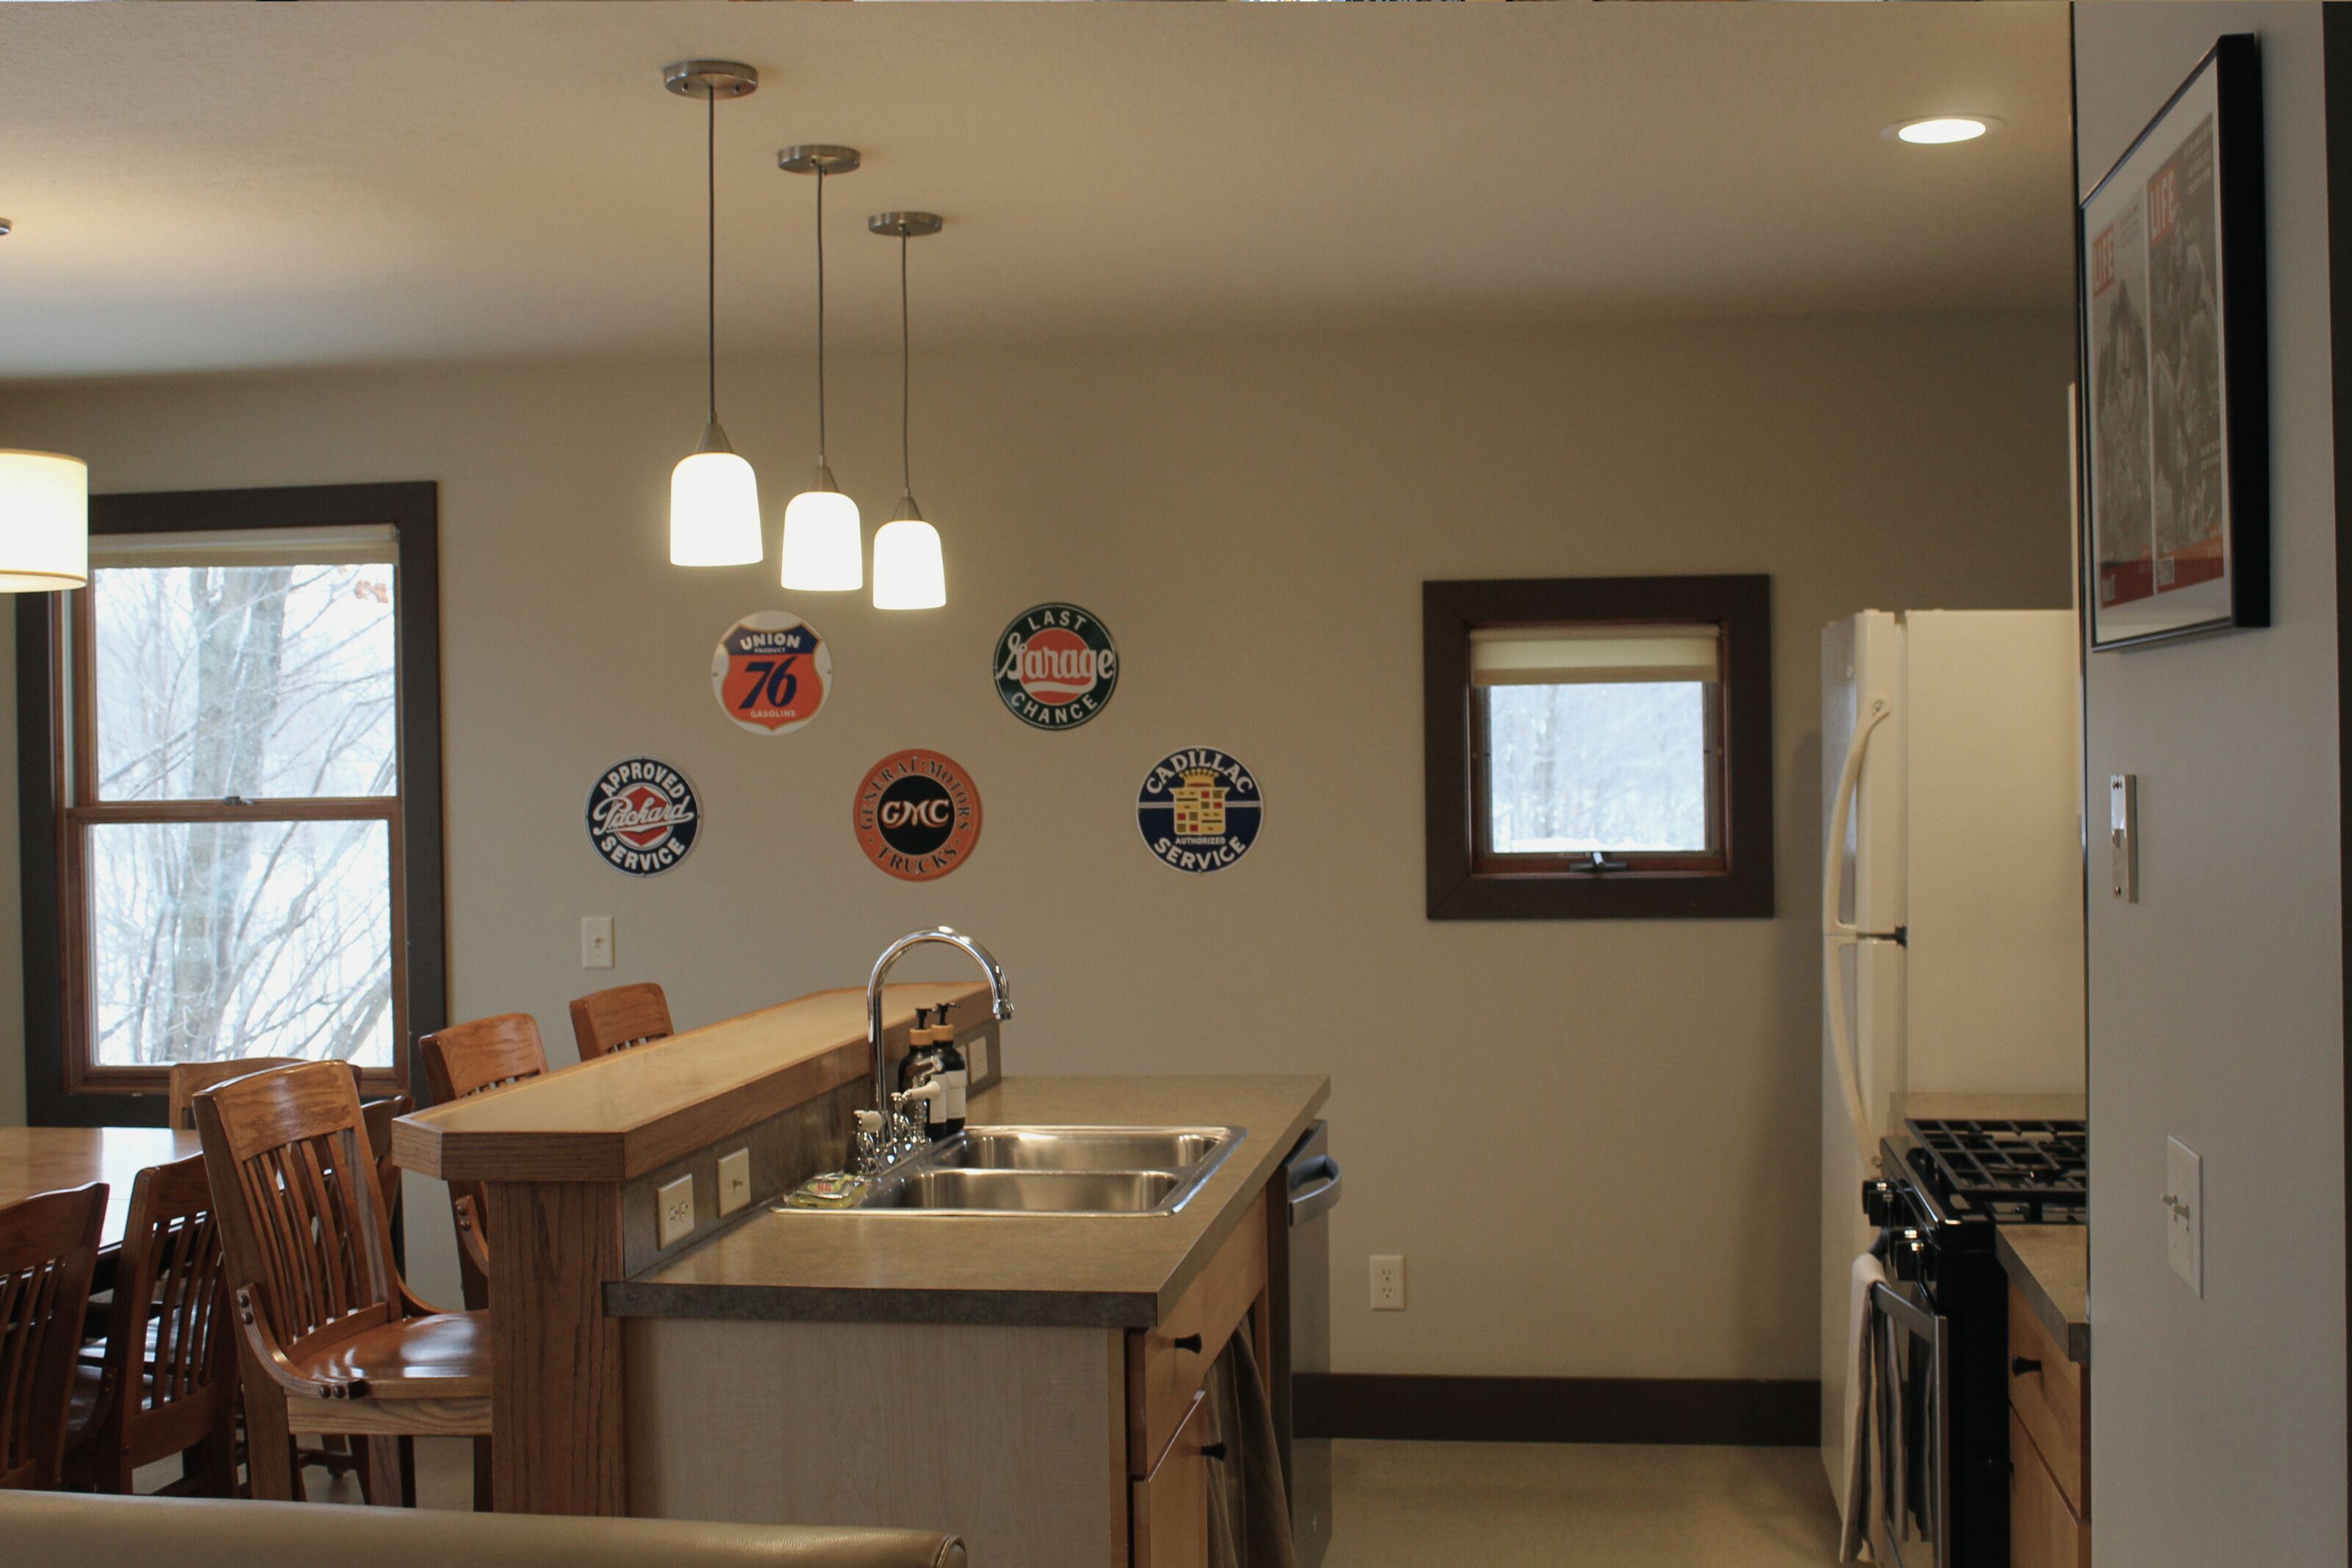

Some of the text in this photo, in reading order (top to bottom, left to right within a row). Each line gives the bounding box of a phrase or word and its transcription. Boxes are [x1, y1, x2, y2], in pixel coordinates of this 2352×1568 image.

[2150, 170, 2176, 241] LIFE
[2093, 231, 2114, 295] LIFE
[1028, 611, 1087, 630] LAST
[739, 633, 800, 650] UNION
[996, 632, 1115, 694] Garage
[739, 655, 797, 709] 76
[750, 710, 797, 719] GASOLINE
[1011, 692, 1098, 724] CHANCE
[600, 762, 685, 799] APPROVED
[1146, 750, 1254, 794] CADILLAC
[860, 758, 970, 832] GENERAL MOTORS
[592, 795, 695, 836] Packard
[881, 798, 951, 829] GMC
[600, 835, 686, 871] SERVICE
[877, 843, 958, 874] TRUCKS
[1154, 835, 1247, 870] SERVICE
[1175, 836, 1226, 845] AUTHORIZED
